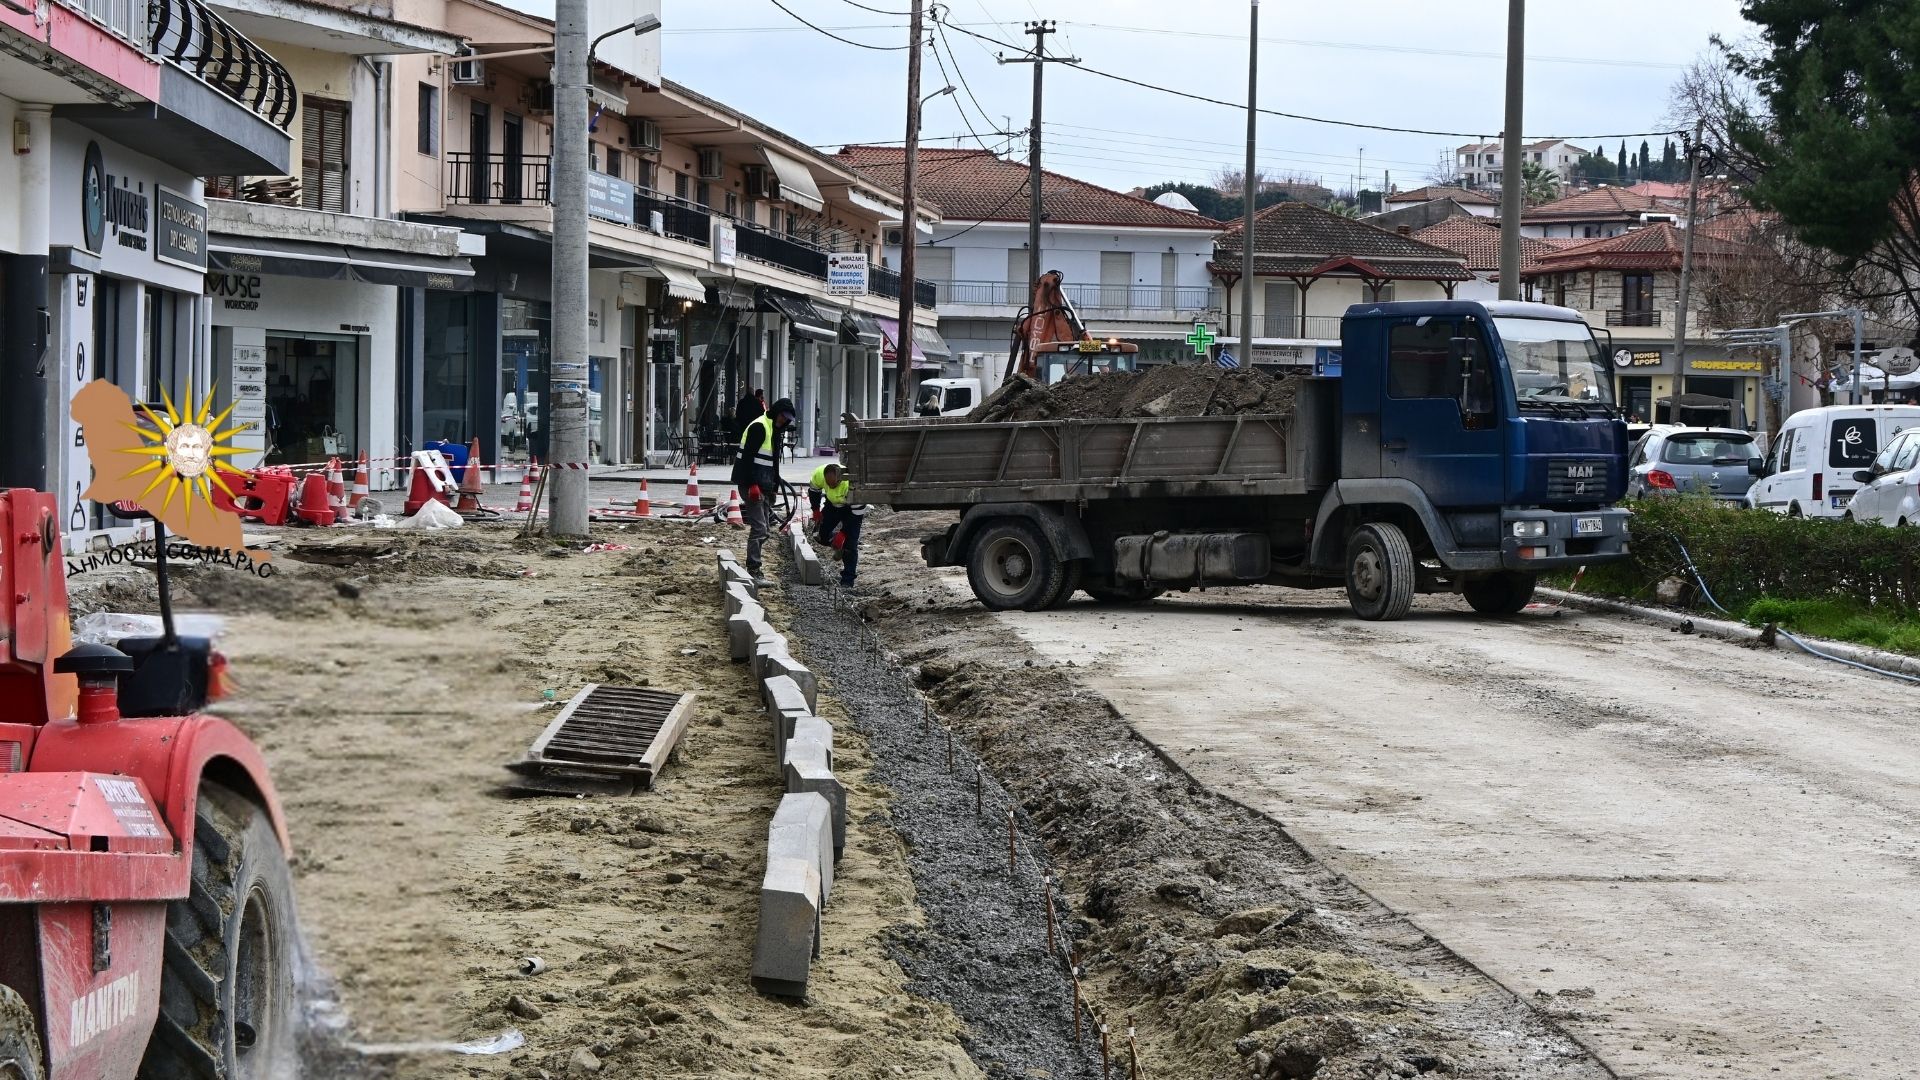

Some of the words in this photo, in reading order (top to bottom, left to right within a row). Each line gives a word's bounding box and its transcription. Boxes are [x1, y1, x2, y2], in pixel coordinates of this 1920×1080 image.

[170, 229, 179, 249] DRY
[179, 231, 198, 255] CLEANING
[224, 300, 259, 311] WORKSHOP
[1633, 358, 1661, 366] &POPS
[1567, 466, 1593, 478] MAN
[70, 970, 139, 1048] MANITOU
